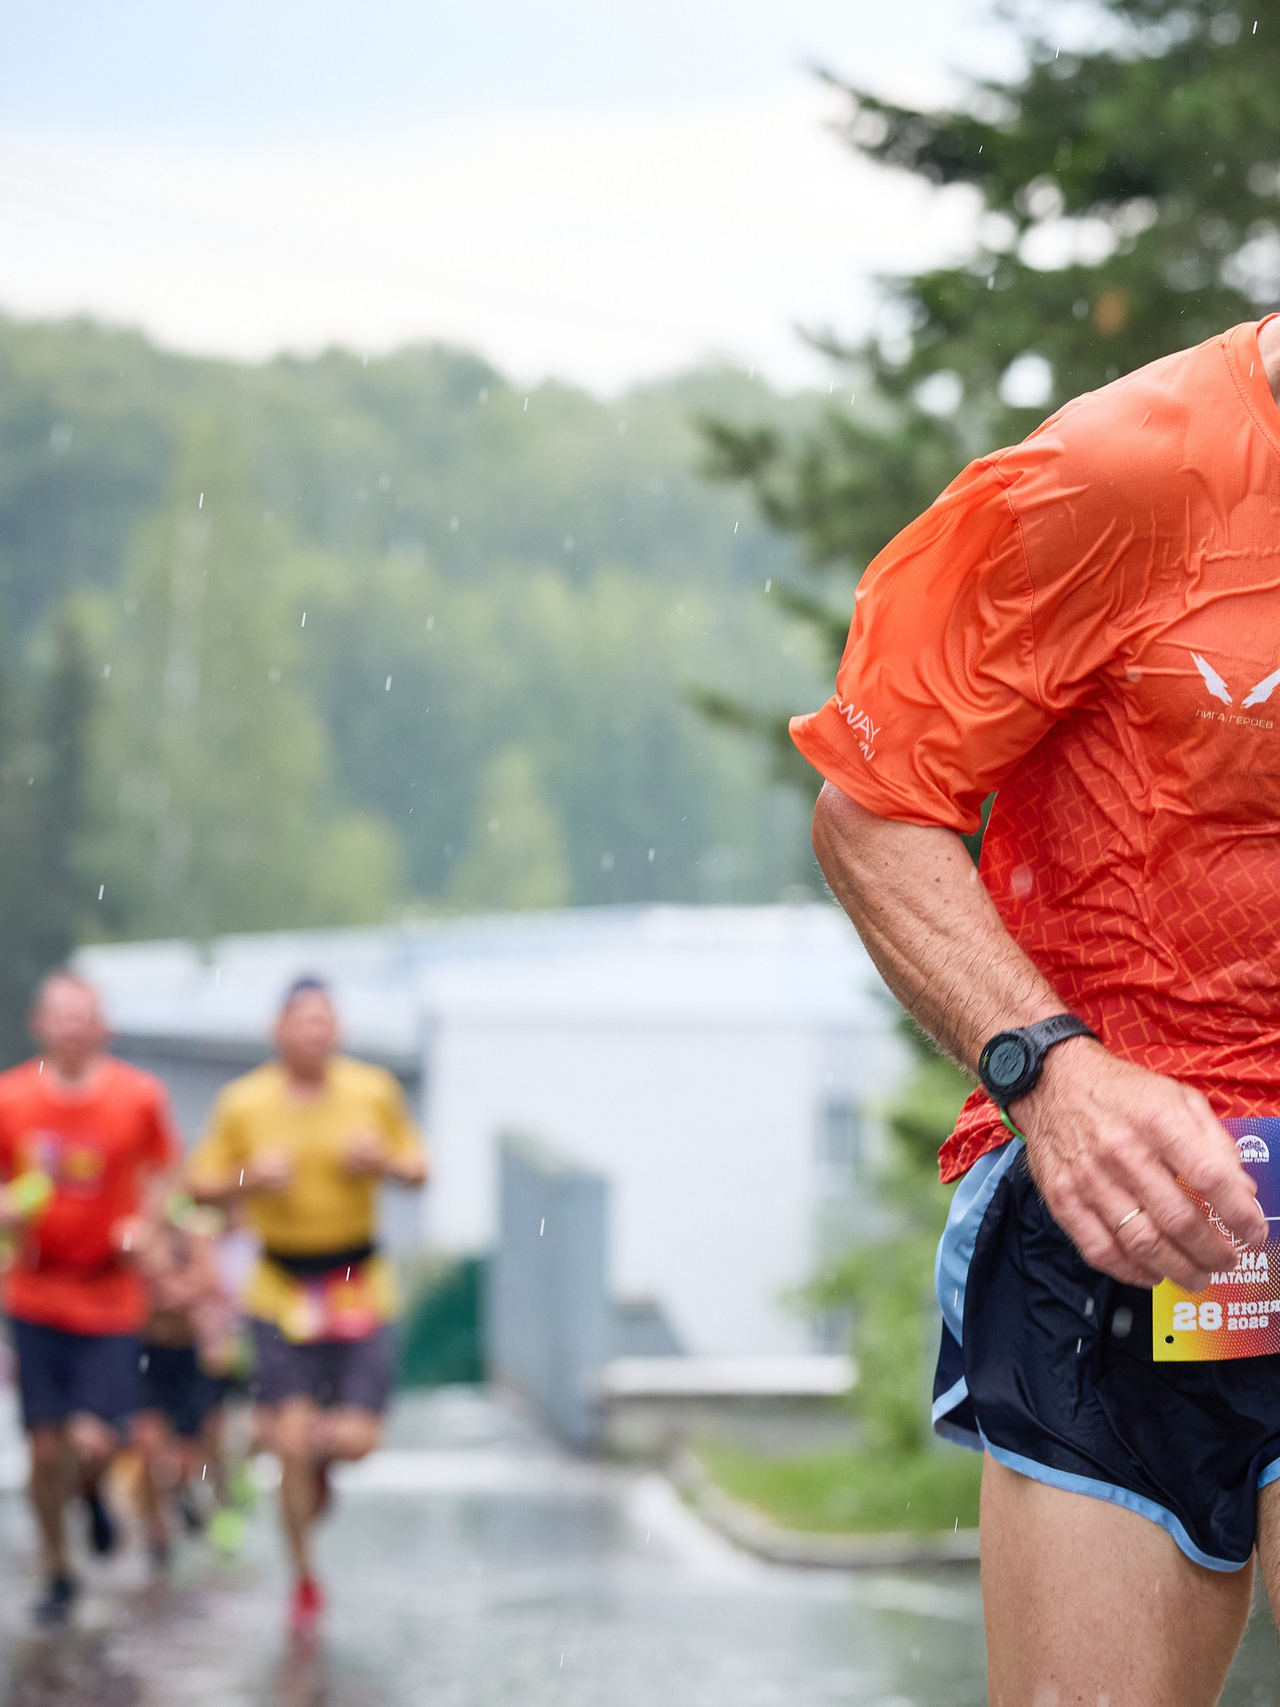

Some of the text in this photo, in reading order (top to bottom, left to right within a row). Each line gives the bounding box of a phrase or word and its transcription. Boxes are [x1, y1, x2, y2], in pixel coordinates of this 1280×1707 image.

[1195, 709, 1274, 729] ЛИГА ГЕРОЕВ
[1209, 1271, 1270, 1285] ИАТЛОНА
[1172, 1299, 1280, 1331] 28 ИЮНЯ
[1227, 1315, 1269, 1331] 2026
